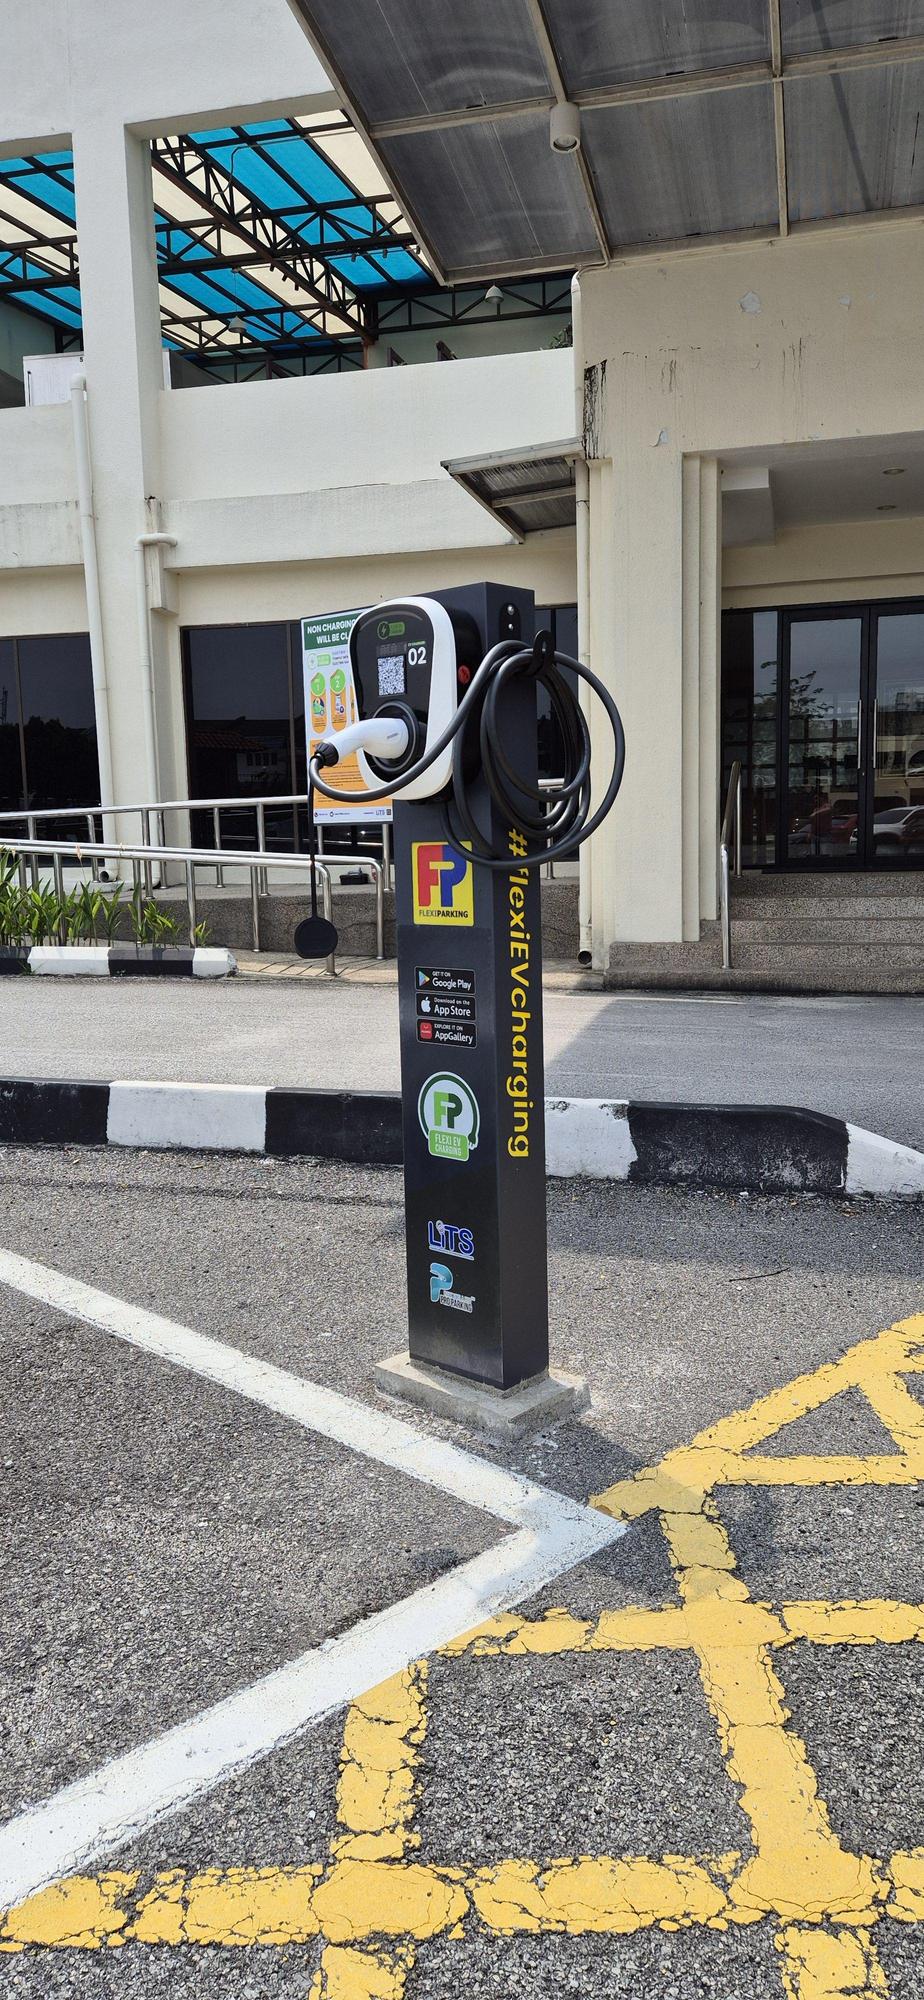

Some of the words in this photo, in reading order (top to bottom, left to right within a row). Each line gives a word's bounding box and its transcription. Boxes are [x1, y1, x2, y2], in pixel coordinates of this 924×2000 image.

[307, 624, 322, 634] NON
[316, 635, 331, 644] WILL
[331, 632, 340, 642] BE
[408, 647, 427, 666] 02
[417, 844, 467, 908] FP
[418, 909, 469, 918] FLEXIPARKING
[432, 977, 457, 990] Google
[457, 979, 472, 991] Play
[434, 1004, 450, 1016] App
[450, 1005, 471, 1017] Store
[434, 1031, 473, 1044] AppGallery
[433, 1091, 463, 1129] FP
[434, 1133, 452, 1146] FLEXI
[453, 1136, 461, 1147] EV
[434, 1144, 462, 1156] CHARGING
